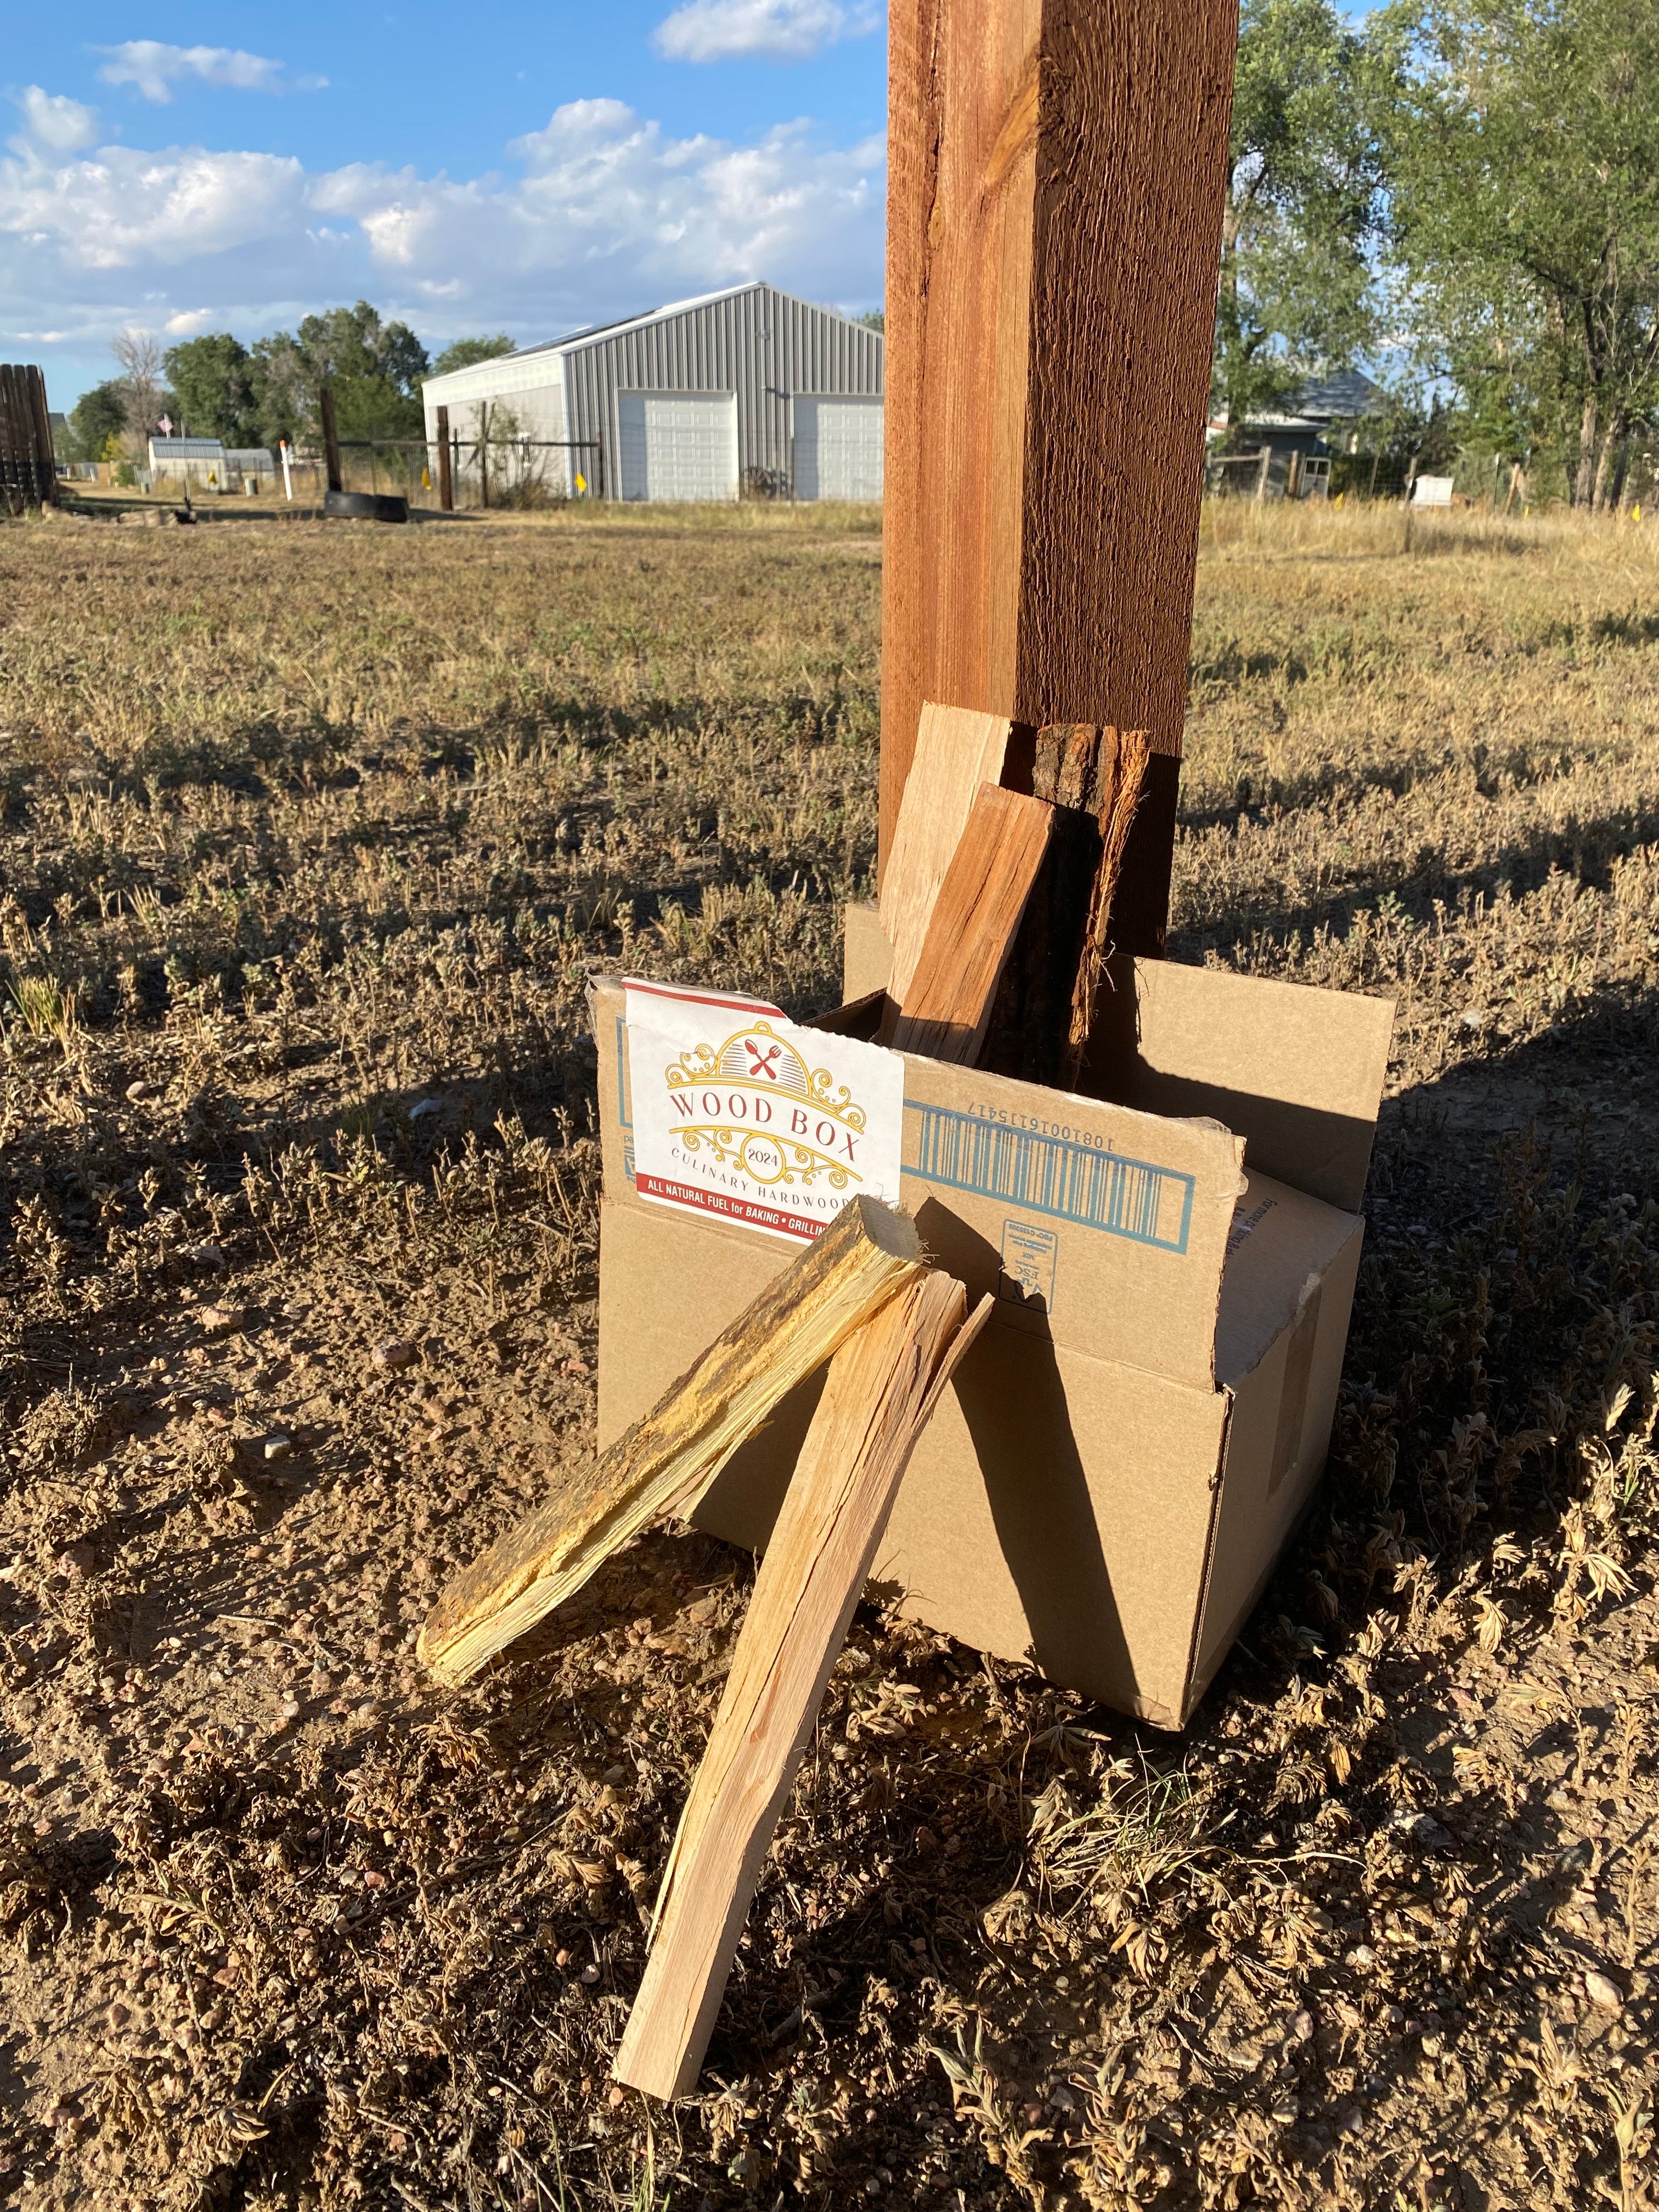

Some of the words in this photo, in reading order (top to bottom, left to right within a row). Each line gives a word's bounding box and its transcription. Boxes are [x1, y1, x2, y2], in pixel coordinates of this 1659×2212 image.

[669, 1092, 772, 1123] WOOD
[791, 1108, 859, 1162] BOX
[967, 1102, 1115, 1152] 10810016115417
[671, 1147, 749, 1192] CULINARY
[748, 1148, 778, 1167] 2024
[647, 1178, 664, 1194] ALL
[665, 1182, 706, 1205] NATURAL
[707, 1195, 729, 1212] FUEL
[731, 1201, 743, 1215] for
[746, 1206, 780, 1224] BAKING
[788, 1217, 826, 1237] GRILLIN
[1014, 1265, 1040, 1280] FSC
